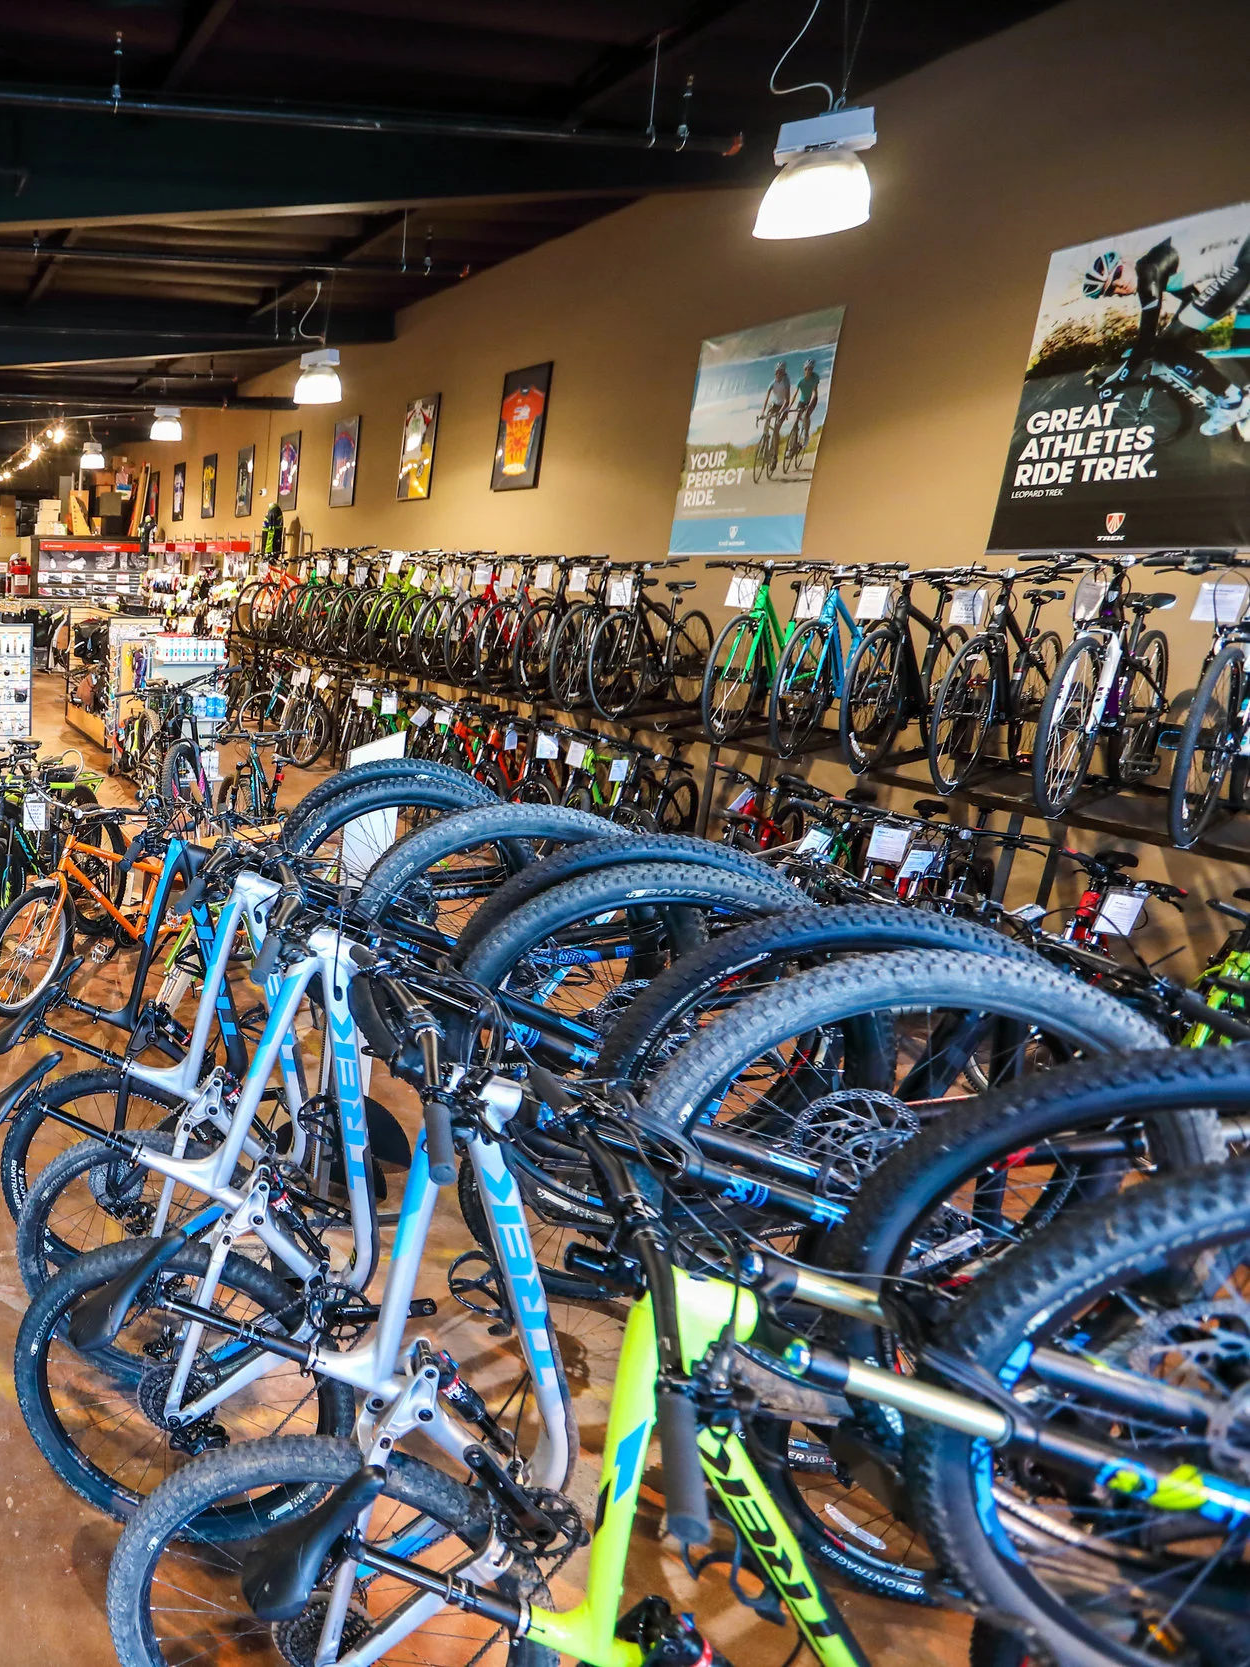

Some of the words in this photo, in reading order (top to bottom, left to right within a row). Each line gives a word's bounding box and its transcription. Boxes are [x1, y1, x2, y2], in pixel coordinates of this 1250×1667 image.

[1026, 401, 1121, 435] GREAT
[690, 450, 727, 470] YOUR
[1018, 425, 1155, 461] ATHLETES
[686, 467, 745, 489] PERFECT
[1014, 460, 1076, 487] RIDE
[1080, 453, 1158, 482] TREK.
[683, 489, 716, 507] RIDE.
[1011, 489, 1044, 499] LEOPARD
[1045, 488, 1064, 497] TREK
[297, 822, 328, 855] BONTRA
[643, 888, 759, 911] BONTRAGER
[331, 1011, 366, 1190] TREK
[10, 1159, 22, 1210] BONTRAGER
[481, 1167, 555, 1387] TREK
[34, 1288, 76, 1345] BONTRAGER
[698, 1437, 837, 1653] TREK
[820, 1544, 911, 1593] BONTRAGER
